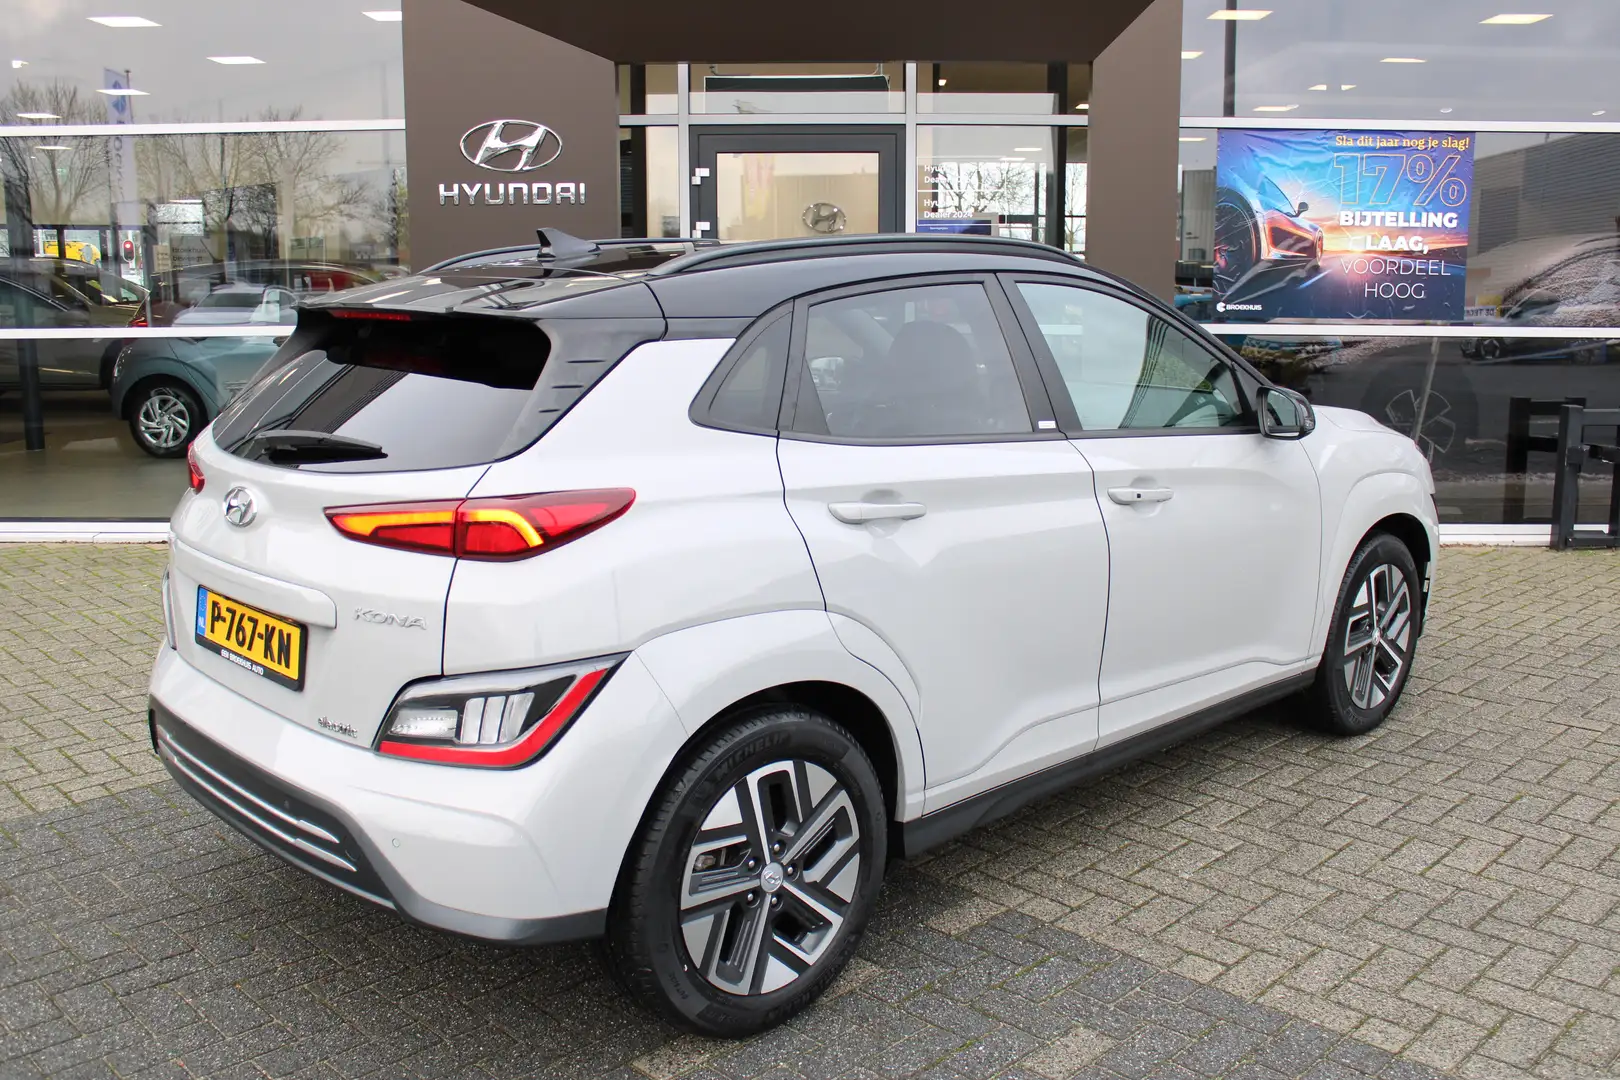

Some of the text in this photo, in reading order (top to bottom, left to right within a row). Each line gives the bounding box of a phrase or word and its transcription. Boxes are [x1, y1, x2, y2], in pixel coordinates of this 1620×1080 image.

[1335, 135, 1470, 151] Sla dit jaar nog je slag!
[1333, 153, 1467, 207] 17%
[438, 182, 586, 206] HYUNDAI
[1339, 210, 1458, 228] BIJTELLING
[1365, 235, 1430, 255] LAAG,
[1340, 258, 1451, 276] VOORDEEL
[1364, 282, 1426, 299] HOOG
[197, 616, 206, 629] NL
[354, 607, 428, 630] KONA
[210, 600, 292, 669] P-767-KN
[251, 663, 264, 676] AUTO
[317, 716, 358, 738] electric
